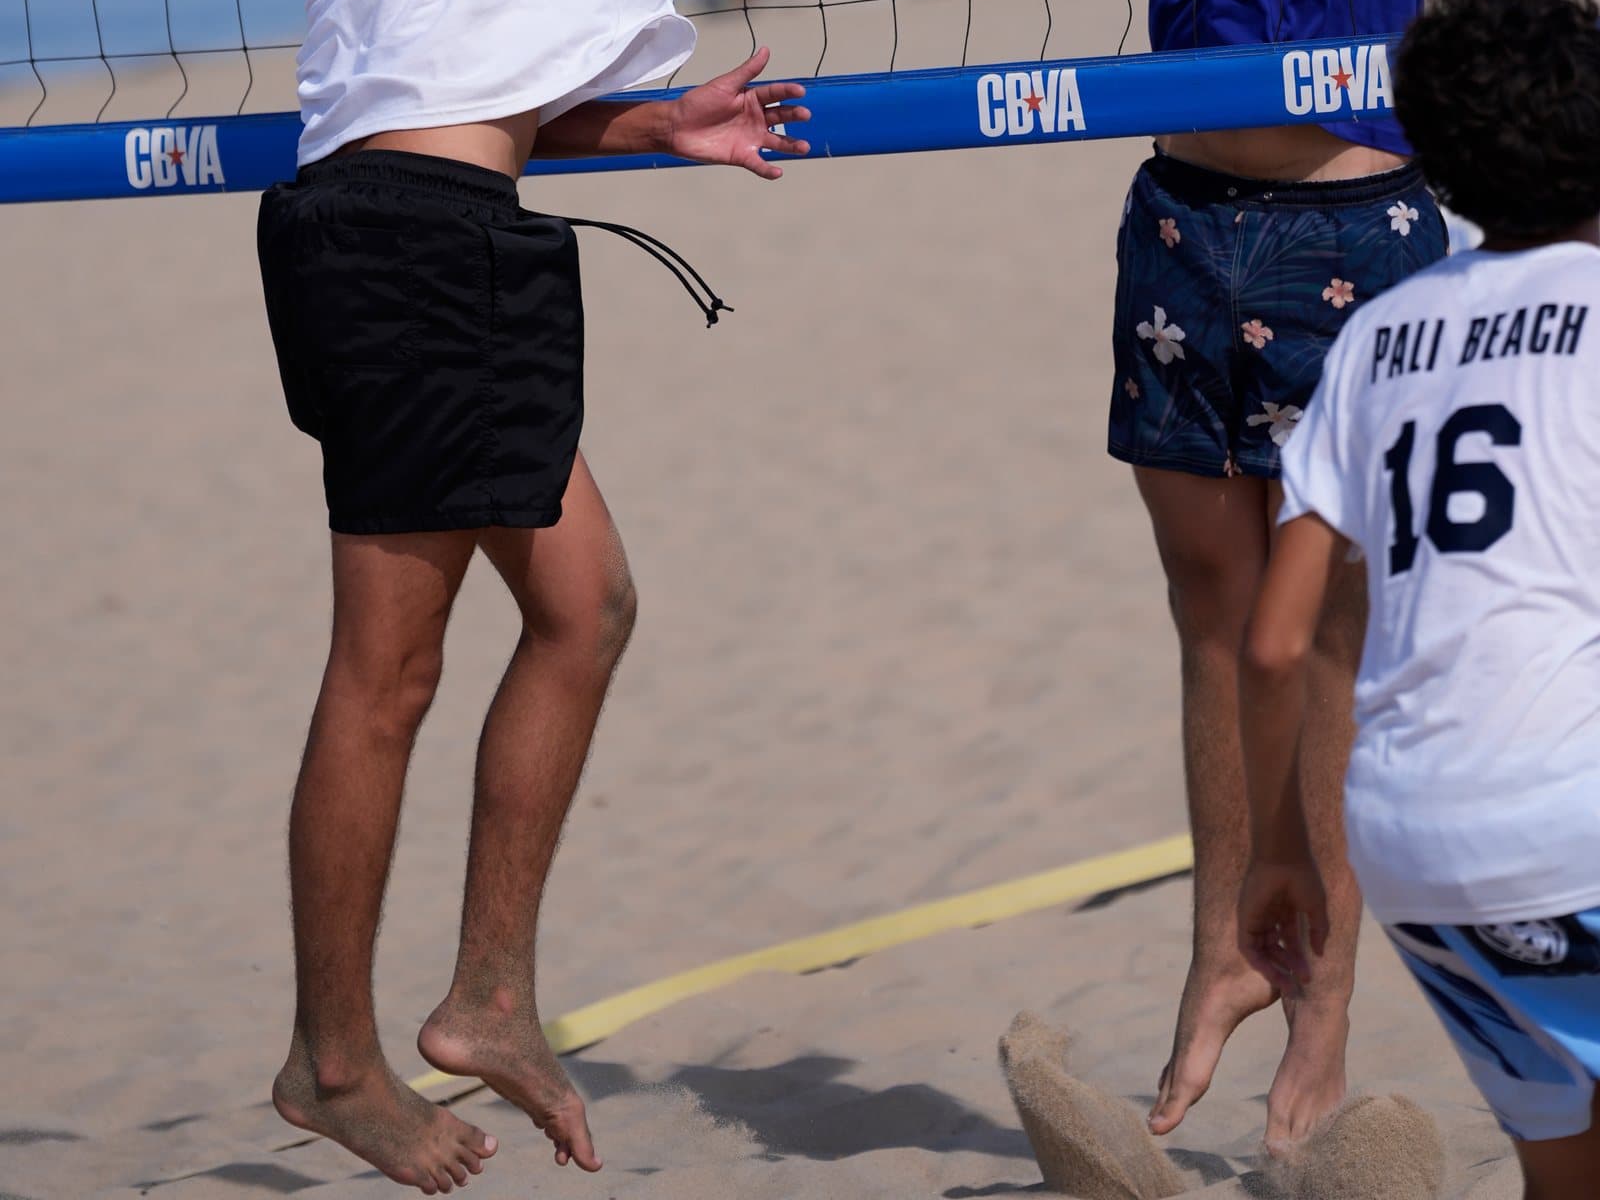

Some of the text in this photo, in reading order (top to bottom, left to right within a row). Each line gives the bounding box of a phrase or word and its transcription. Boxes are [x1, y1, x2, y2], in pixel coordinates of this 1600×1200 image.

[976, 68, 1087, 138] CBVA
[1282, 43, 1396, 116] CBVA
[125, 124, 226, 190] CBVA
[1370, 303, 1589, 385] PALI BEACH
[1383, 403, 1523, 578] 16
